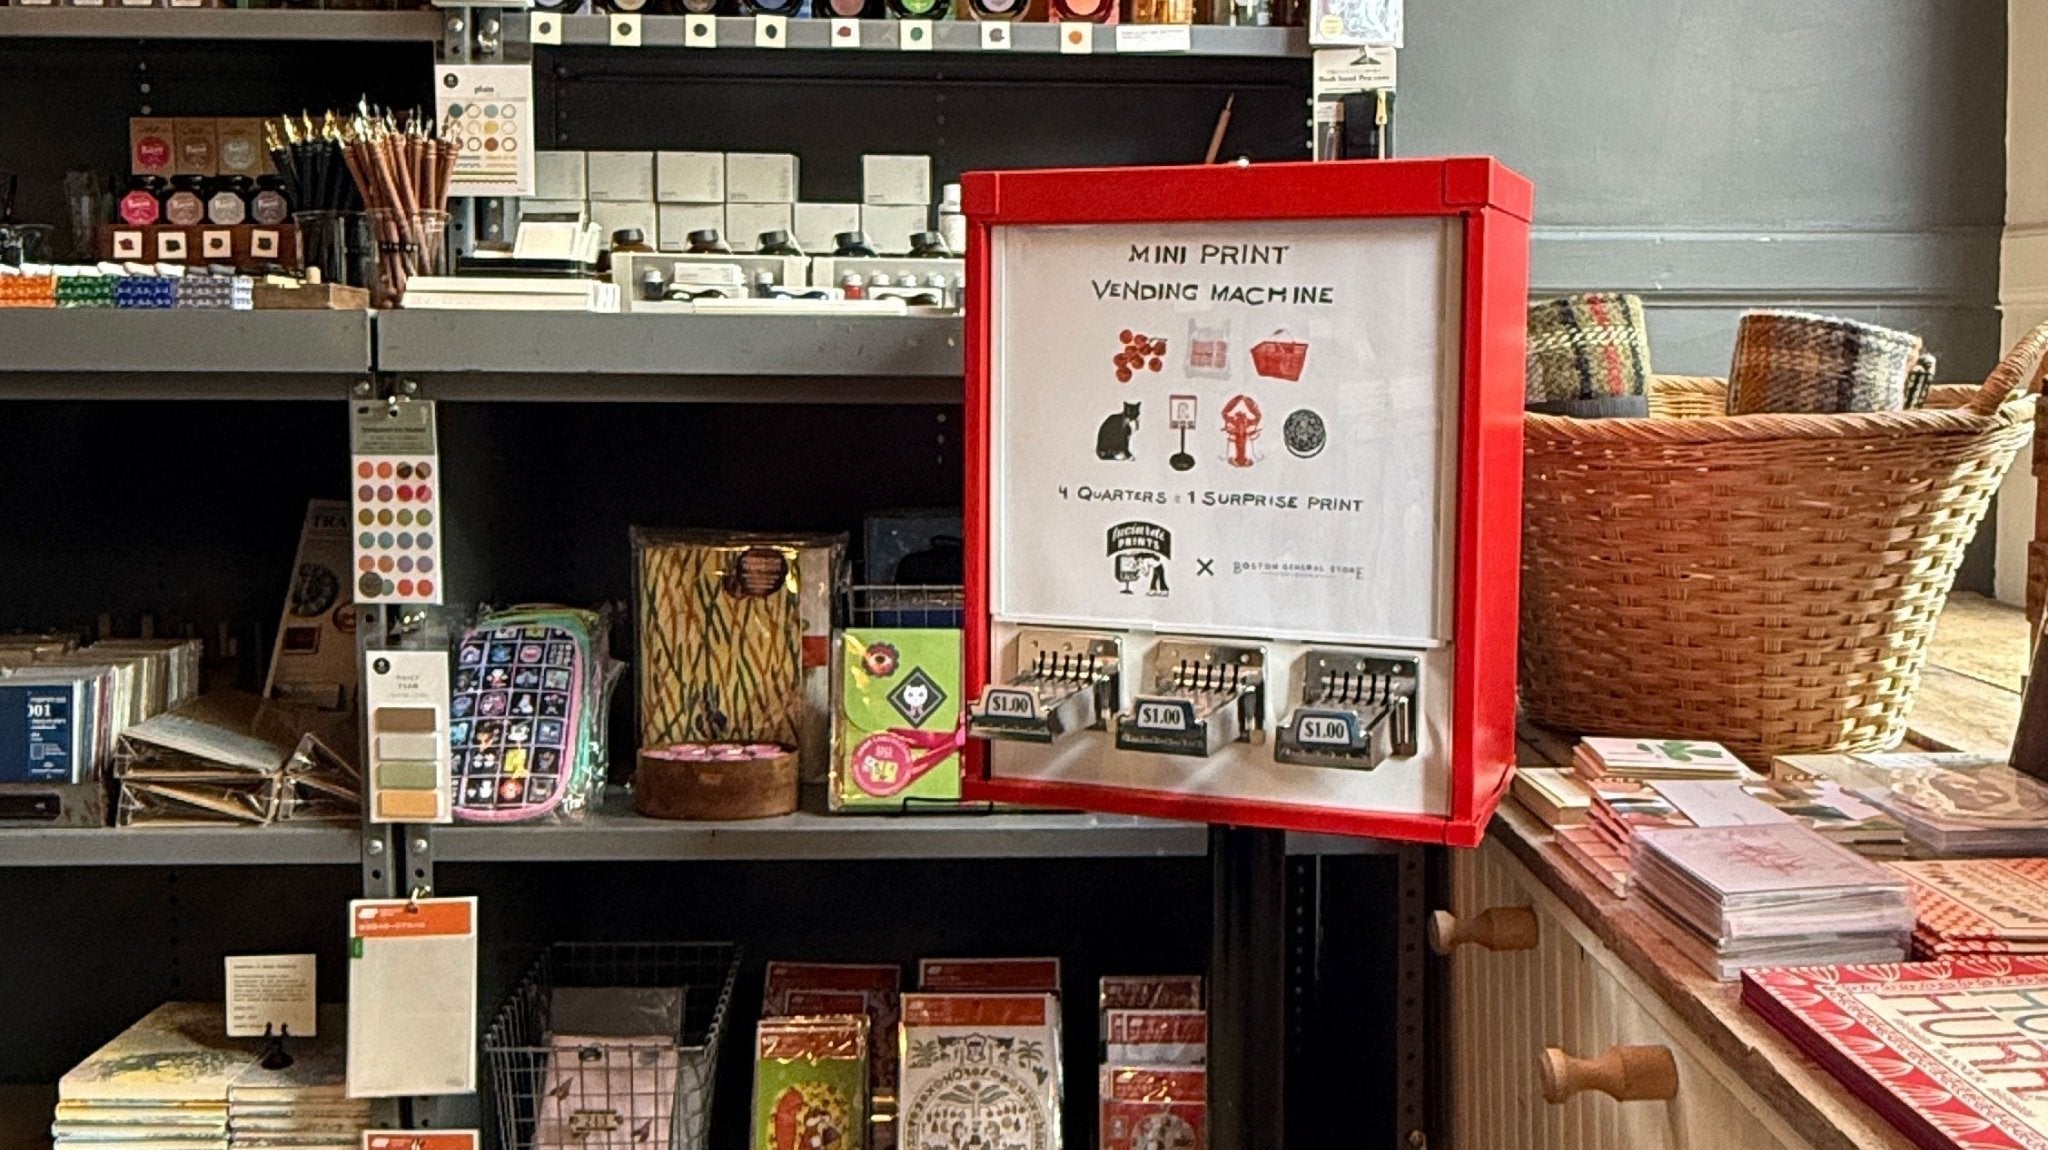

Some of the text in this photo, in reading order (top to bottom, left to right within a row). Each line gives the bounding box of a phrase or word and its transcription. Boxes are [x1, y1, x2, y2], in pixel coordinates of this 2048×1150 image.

[1128, 244, 1290, 265] MINI PRINT
[1091, 279, 1334, 306] VENDING MACHINE
[1058, 484, 1068, 500] 4
[1077, 486, 1167, 504] QUARTERS
[1187, 490, 1196, 504] 1
[1201, 491, 1298, 509] SURPRISE
[1307, 496, 1364, 512] PRINT
[1117, 537, 1160, 551] PRINTS
[1233, 560, 1279, 575] BOSTON
[1329, 564, 1364, 580] STORE
[992, 695, 1030, 713] $1.00
[1142, 706, 1181, 725] $1.00
[1304, 720, 1345, 739] $1.00
